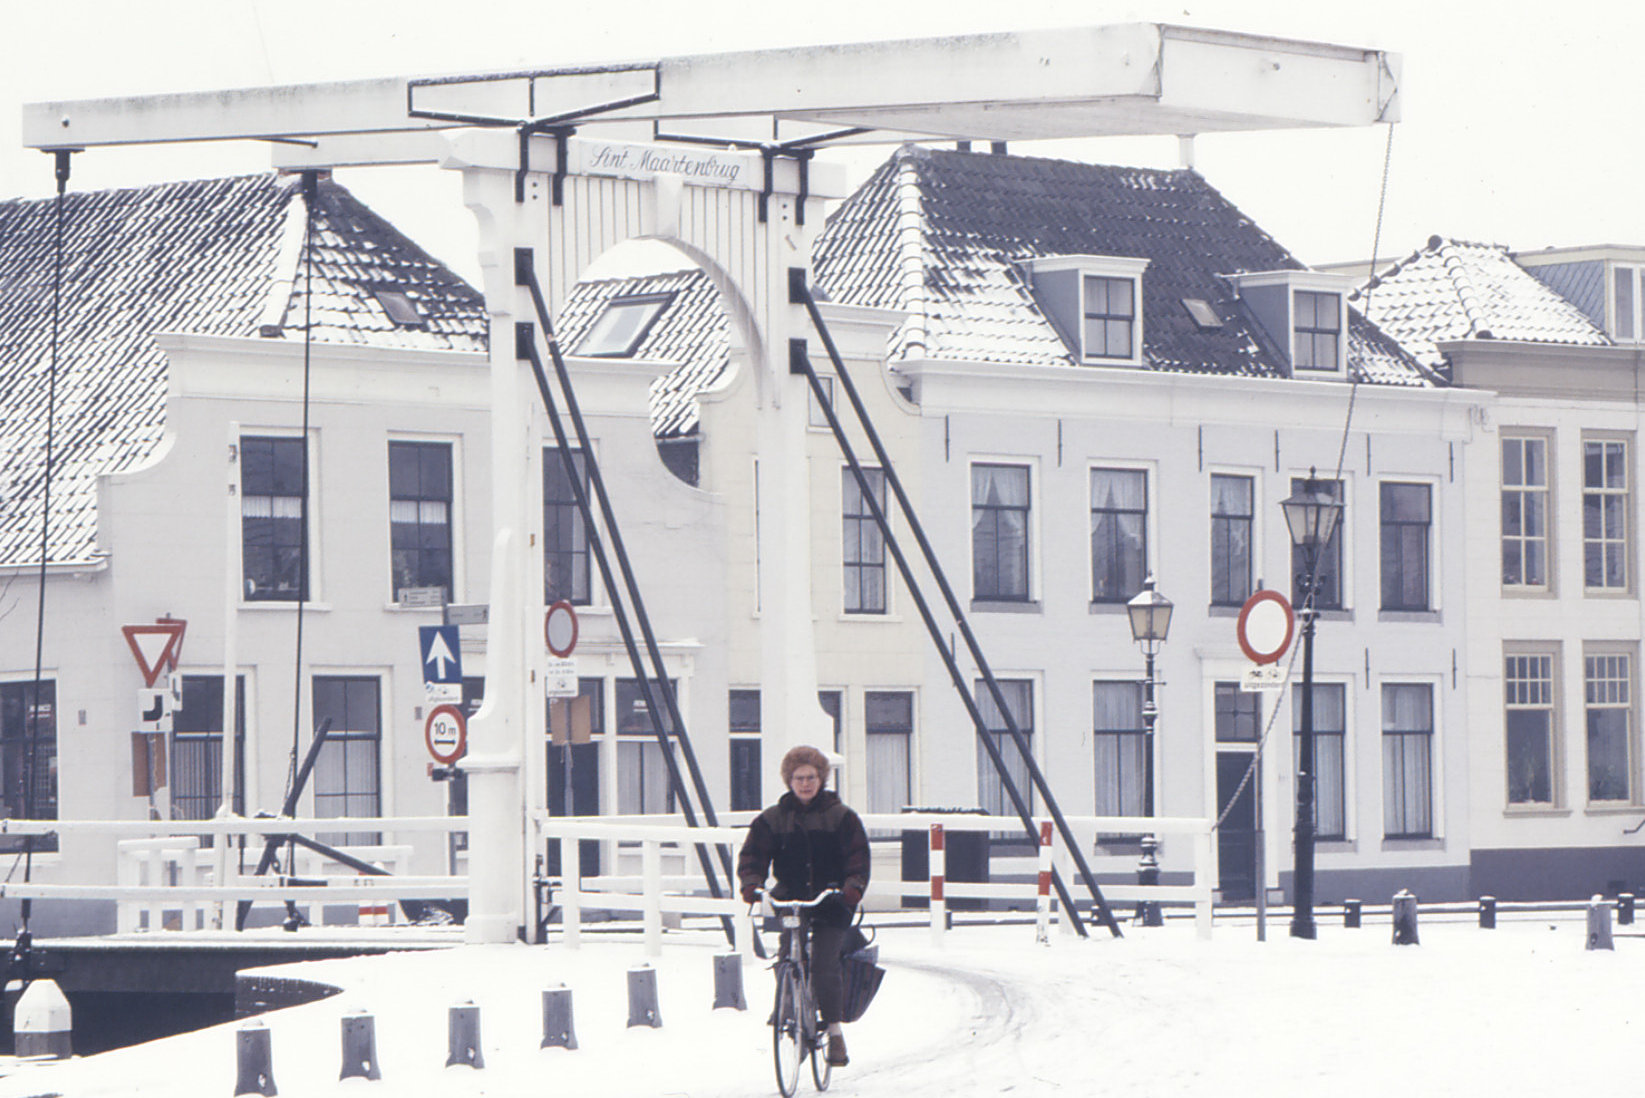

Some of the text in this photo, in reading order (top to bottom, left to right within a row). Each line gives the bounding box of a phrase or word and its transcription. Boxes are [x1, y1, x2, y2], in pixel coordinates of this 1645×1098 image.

[591, 145, 740, 184] Sint Maartenbrug
[434, 721, 456, 735] 10 m
